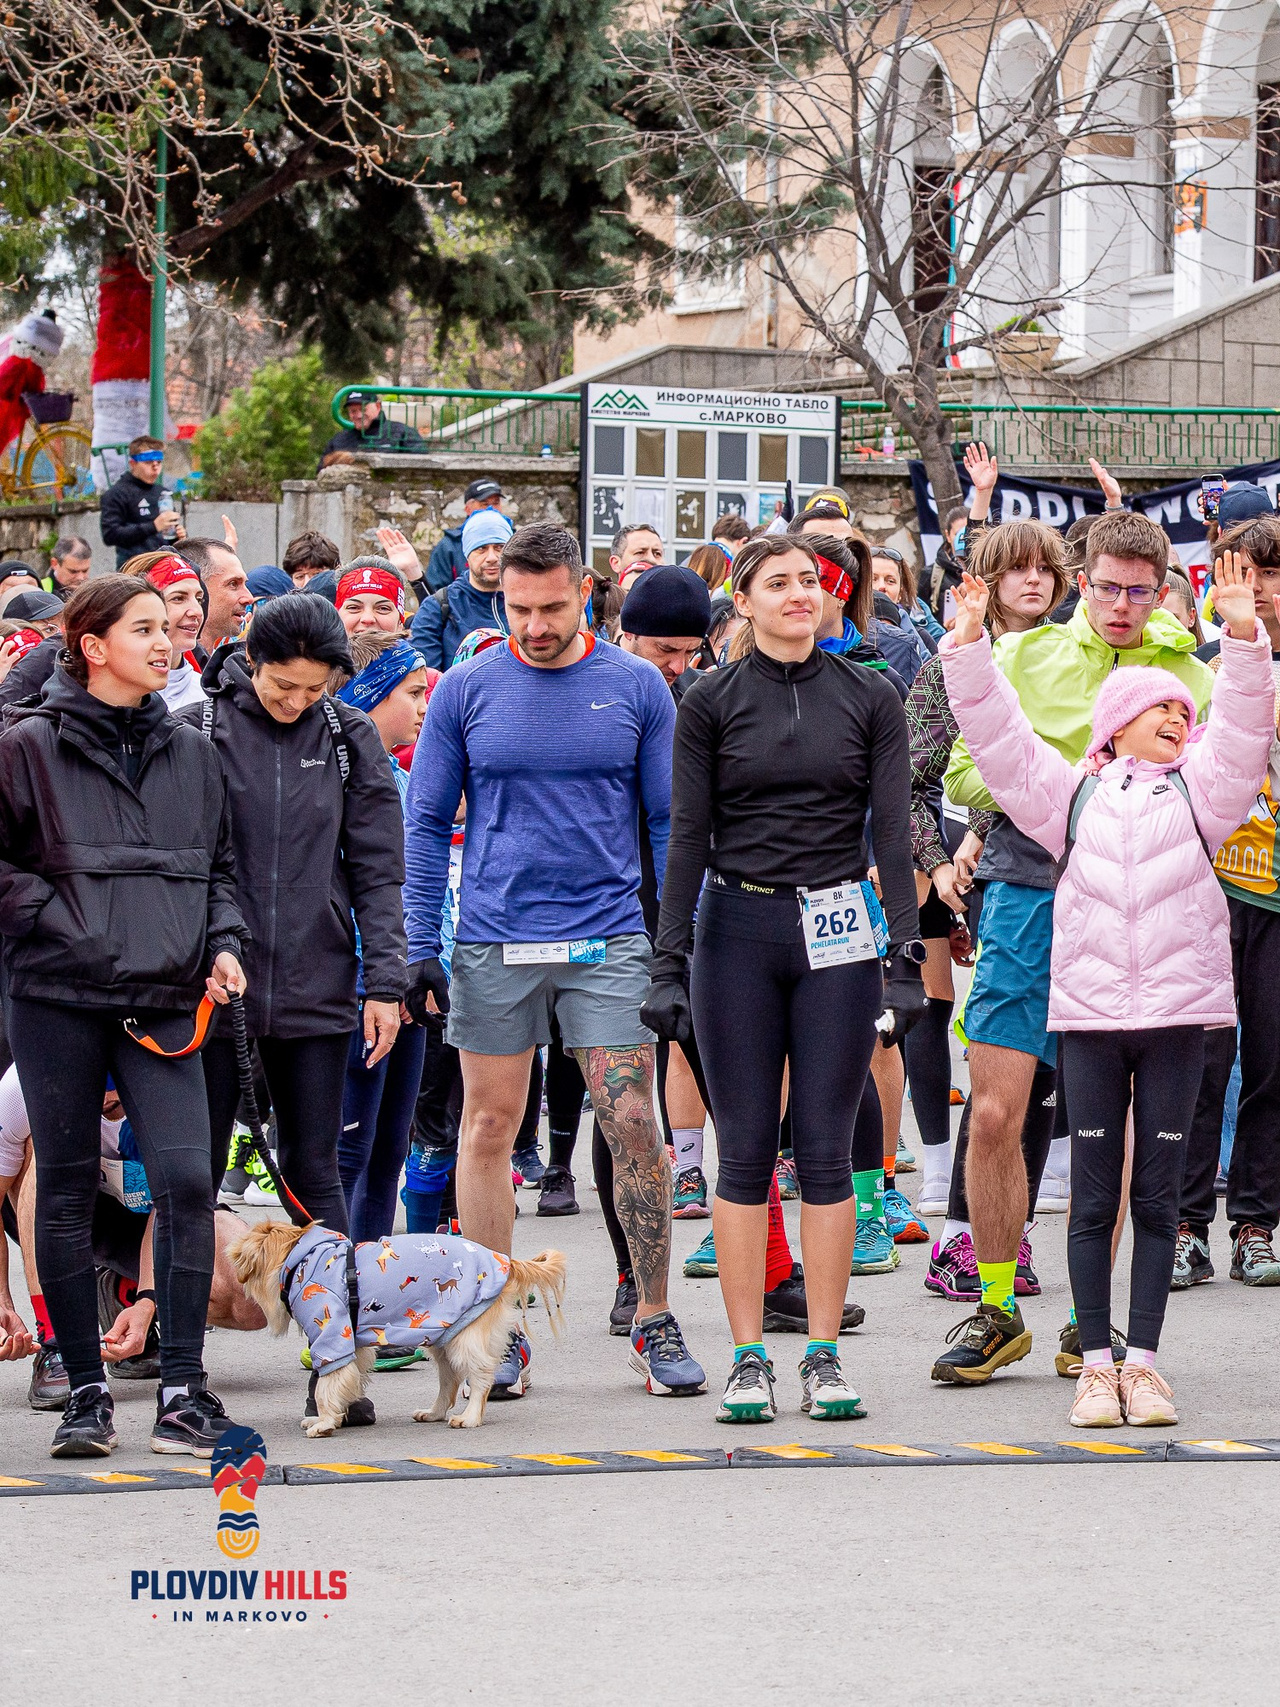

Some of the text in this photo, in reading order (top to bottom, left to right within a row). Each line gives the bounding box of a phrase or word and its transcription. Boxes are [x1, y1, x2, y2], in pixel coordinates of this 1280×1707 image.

[656, 391, 829, 410] ИНФОРМАЦИОННО ТАБЛО
[699, 410, 787, 425] с.МАРКОВО
[832, 891, 843, 900] 8K
[814, 908, 859, 938] 262
[811, 936, 850, 950] PCHELATA RUN
[1078, 1128, 1183, 1141] NIKE PRO
